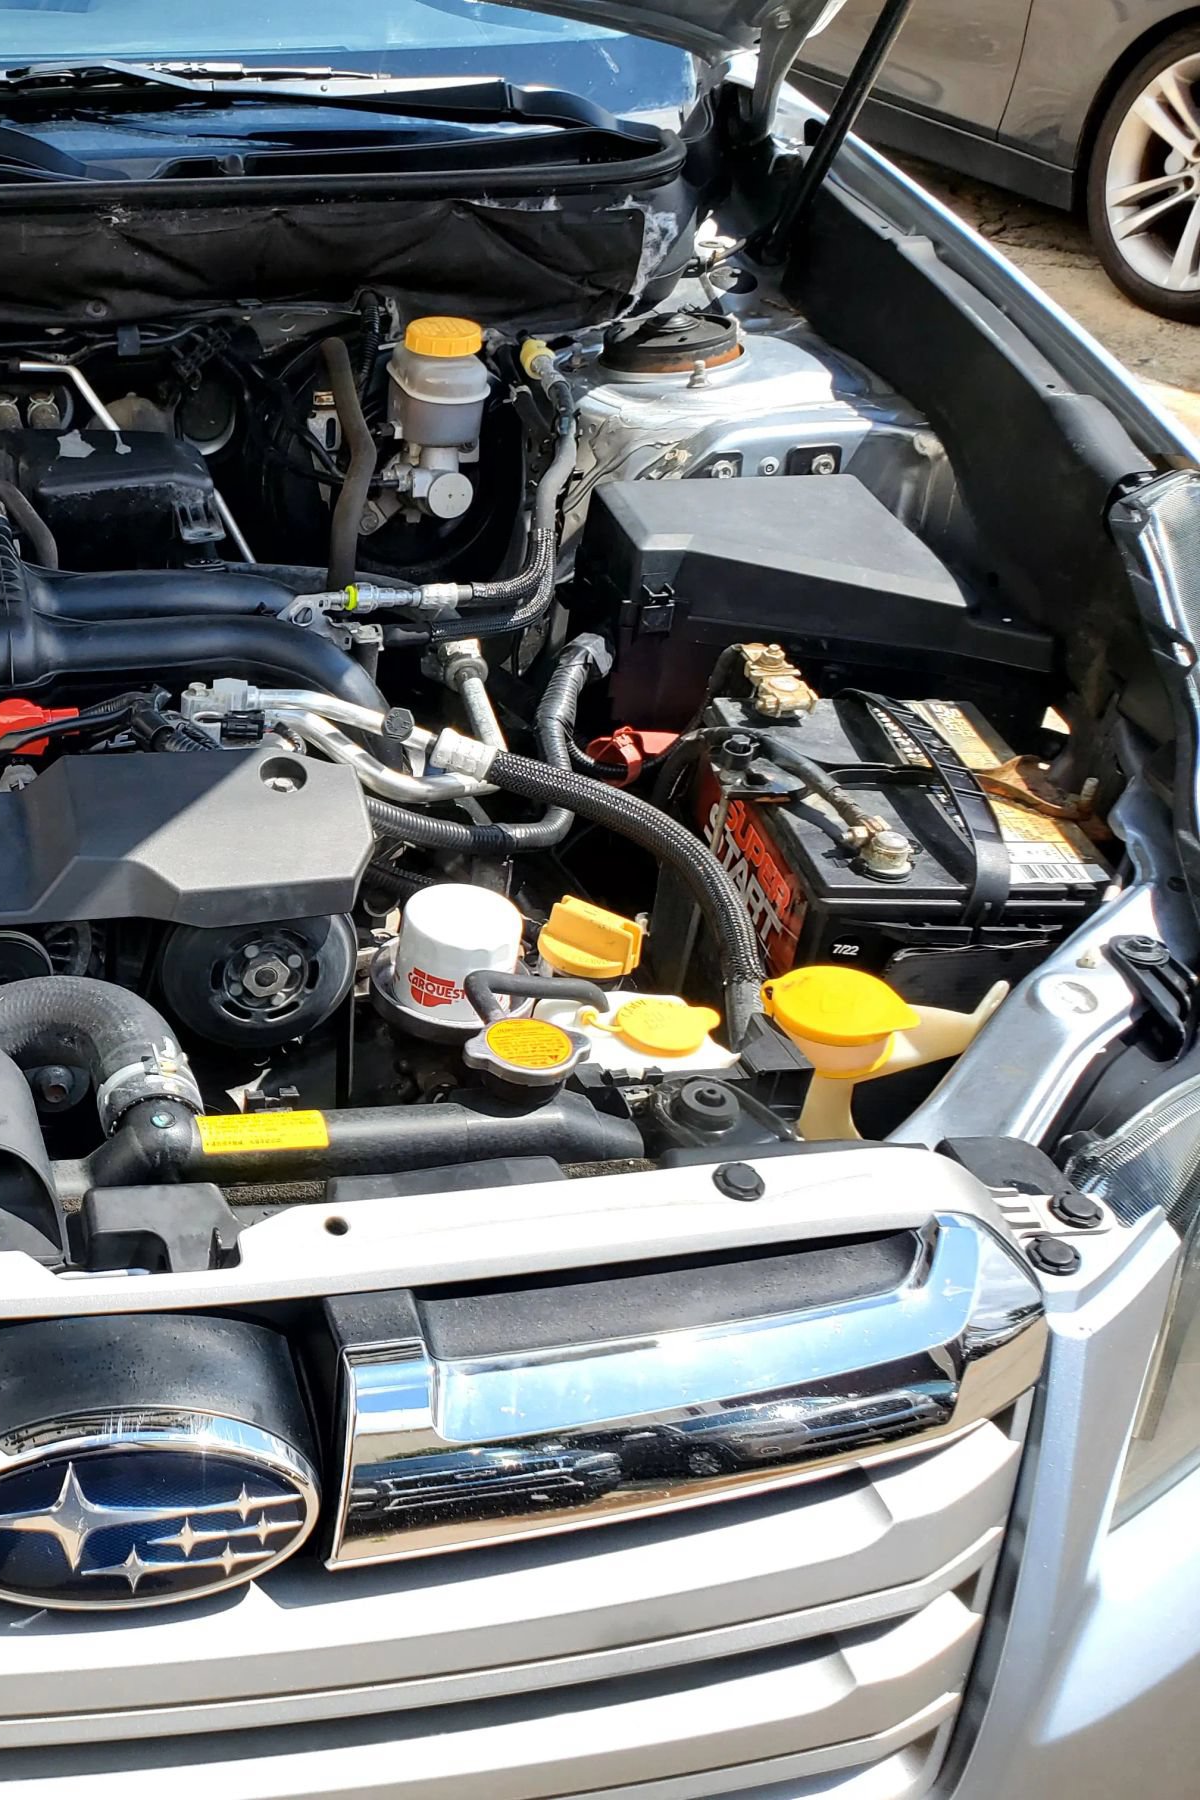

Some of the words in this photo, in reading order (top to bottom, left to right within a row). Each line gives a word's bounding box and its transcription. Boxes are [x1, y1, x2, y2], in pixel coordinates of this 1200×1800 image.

[704, 803, 783, 941] START
[725, 800, 791, 919] SUPER
[832, 944, 860, 956] 7/22
